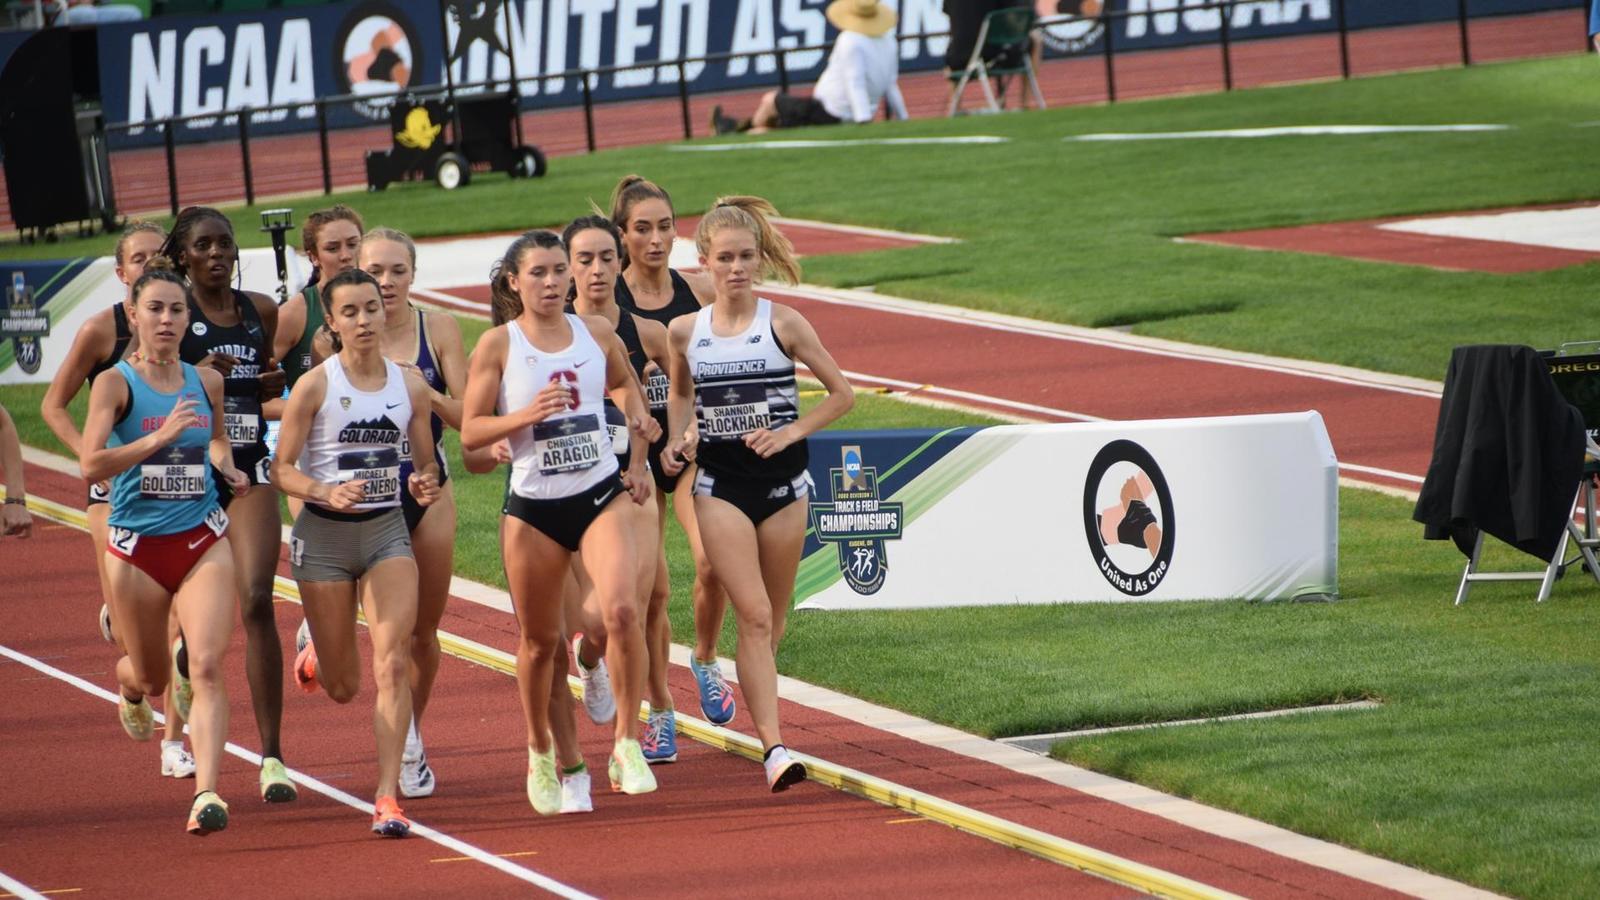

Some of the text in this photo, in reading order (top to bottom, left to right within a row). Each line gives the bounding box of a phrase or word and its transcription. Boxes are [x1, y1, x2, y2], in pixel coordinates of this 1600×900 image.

[128, 18, 316, 135] NCAA
[697, 360, 766, 380] PROVIDENCE
[714, 405, 756, 418] SHANNON
[705, 414, 770, 434] FLOCKHART
[338, 429, 401, 444] COLORADO
[546, 433, 593, 451] CHRISTINA
[542, 443, 600, 467] ARAGON
[165, 466, 186, 476] ABBE
[354, 469, 388, 480] MICAELA
[846, 463, 860, 471] NCAA
[142, 477, 205, 492] GOLDSTEIN
[363, 478, 397, 495] ENERO
[835, 501, 855, 513] TRACK
[862, 500, 879, 512] FIELD
[820, 512, 898, 532] CHAMPIONSHIPS
[1101, 557, 1167, 592] United As One
